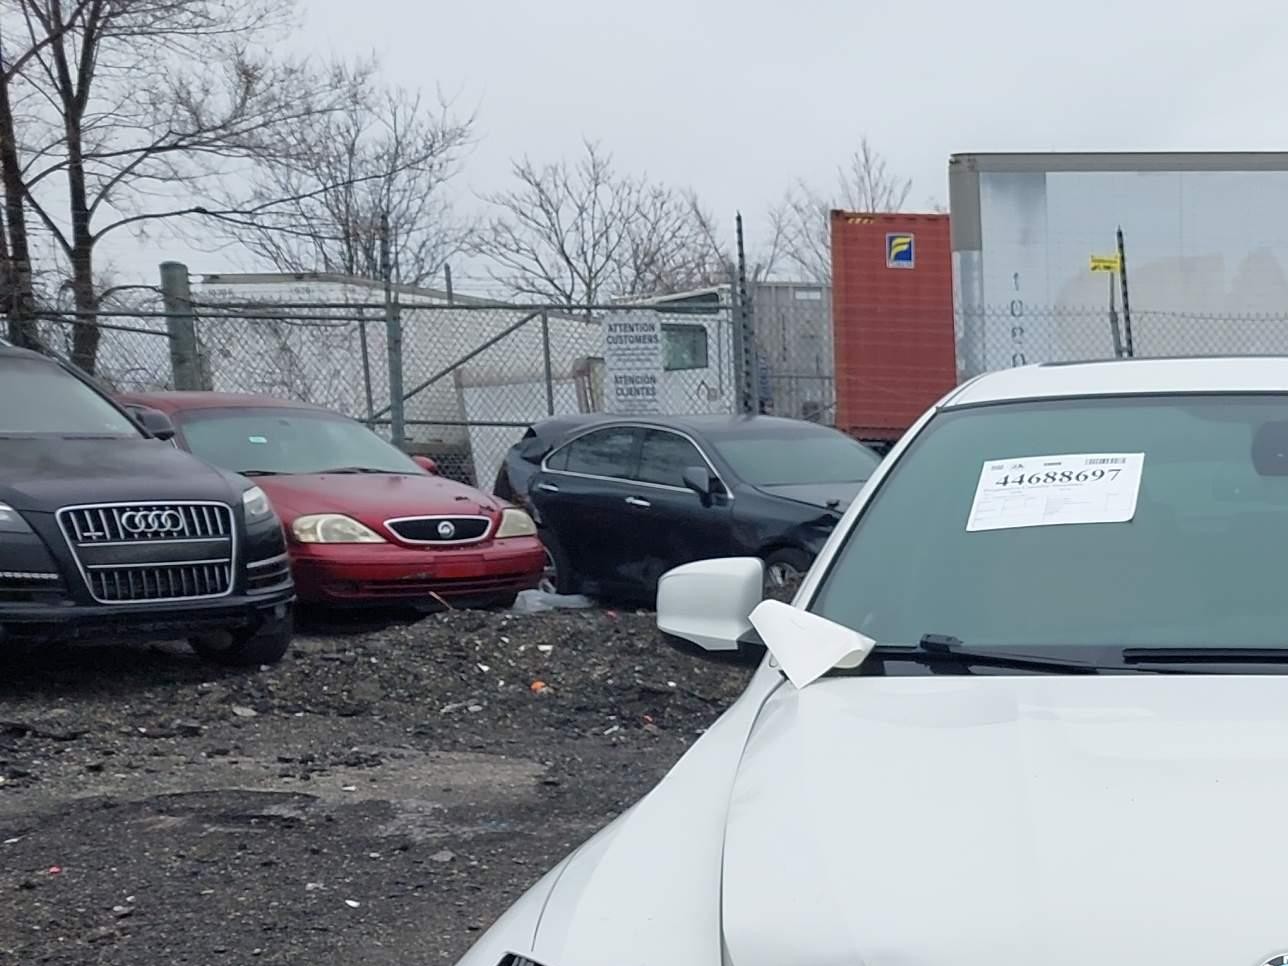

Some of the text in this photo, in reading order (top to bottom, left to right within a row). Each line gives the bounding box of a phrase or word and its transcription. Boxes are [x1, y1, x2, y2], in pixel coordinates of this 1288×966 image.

[607, 322, 656, 333] ATTENTION
[606, 334, 659, 345] CUSTOMERS
[615, 386, 657, 397] CLIENTES
[995, 468, 1122, 487] 44688697
